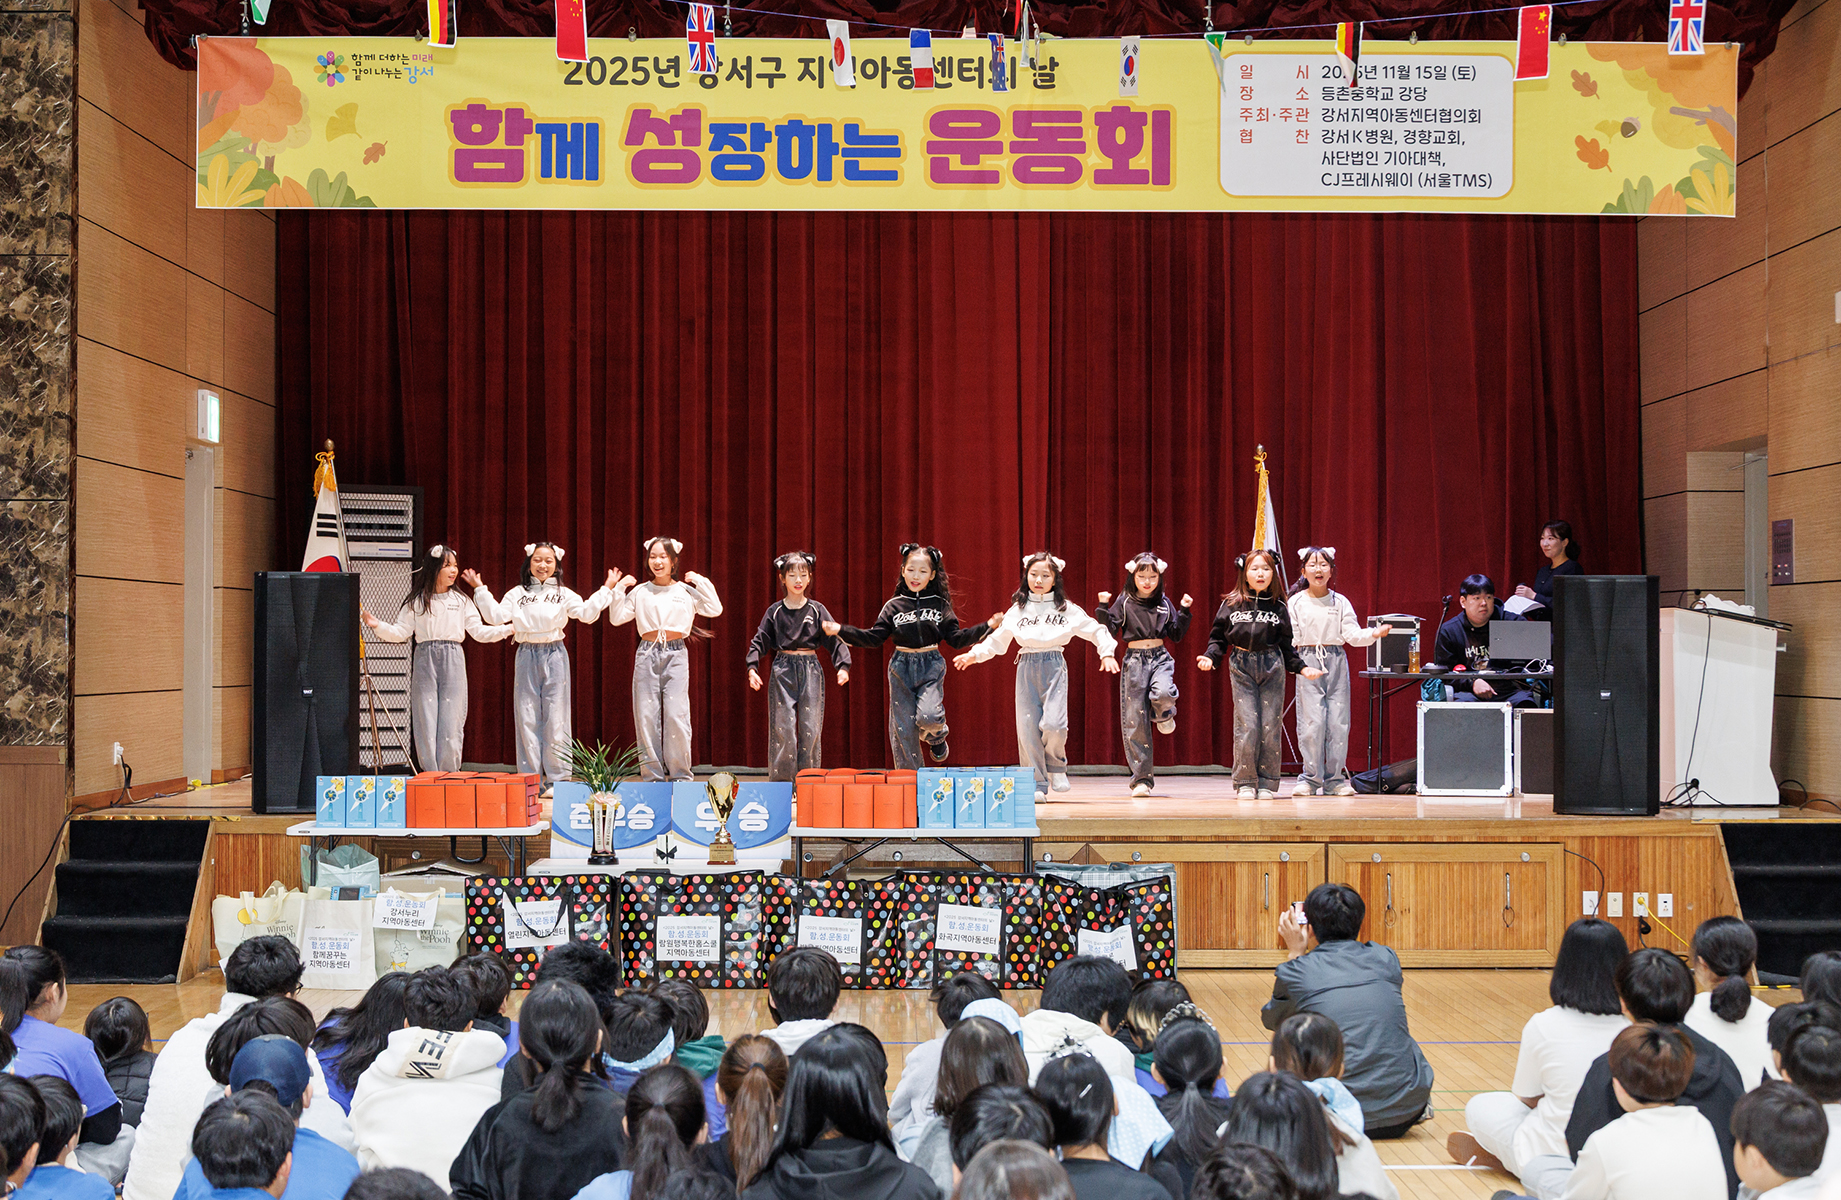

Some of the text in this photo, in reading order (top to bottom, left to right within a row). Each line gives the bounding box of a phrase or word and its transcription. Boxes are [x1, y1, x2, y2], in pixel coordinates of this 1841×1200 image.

[351, 53, 433, 66] 함께 더하는 미래
[352, 66, 434, 84] 같이 나누는 강서
[563, 56, 681, 89] 2025년
[1029, 56, 1060, 89] 날
[1239, 64, 1478, 82] 일 시 205년 11월 15일 (토)
[1239, 86, 1428, 102] 장 소 등촌중학교 강당
[1321, 107, 1482, 124] 강서지역아동센터협의회
[450, 104, 1171, 186] 함께 성장하는 운동회
[1239, 129, 1253, 144] 협
[1295, 129, 1310, 144] 찬
[1403, 129, 1466, 146] 경향교회,
[1321, 151, 1446, 167] 사단법인 기아대책,
[1321, 172, 1493, 189] CJ프레시웨이 (서울TMS)
[390, 908, 420, 917] 강서누리
[382, 917, 426, 927] 지역아동센터
[939, 932, 997, 945] 화곡지역아동센터
[666, 949, 710, 957] 지역아동센터
[309, 960, 350, 969] 지역아동센터
